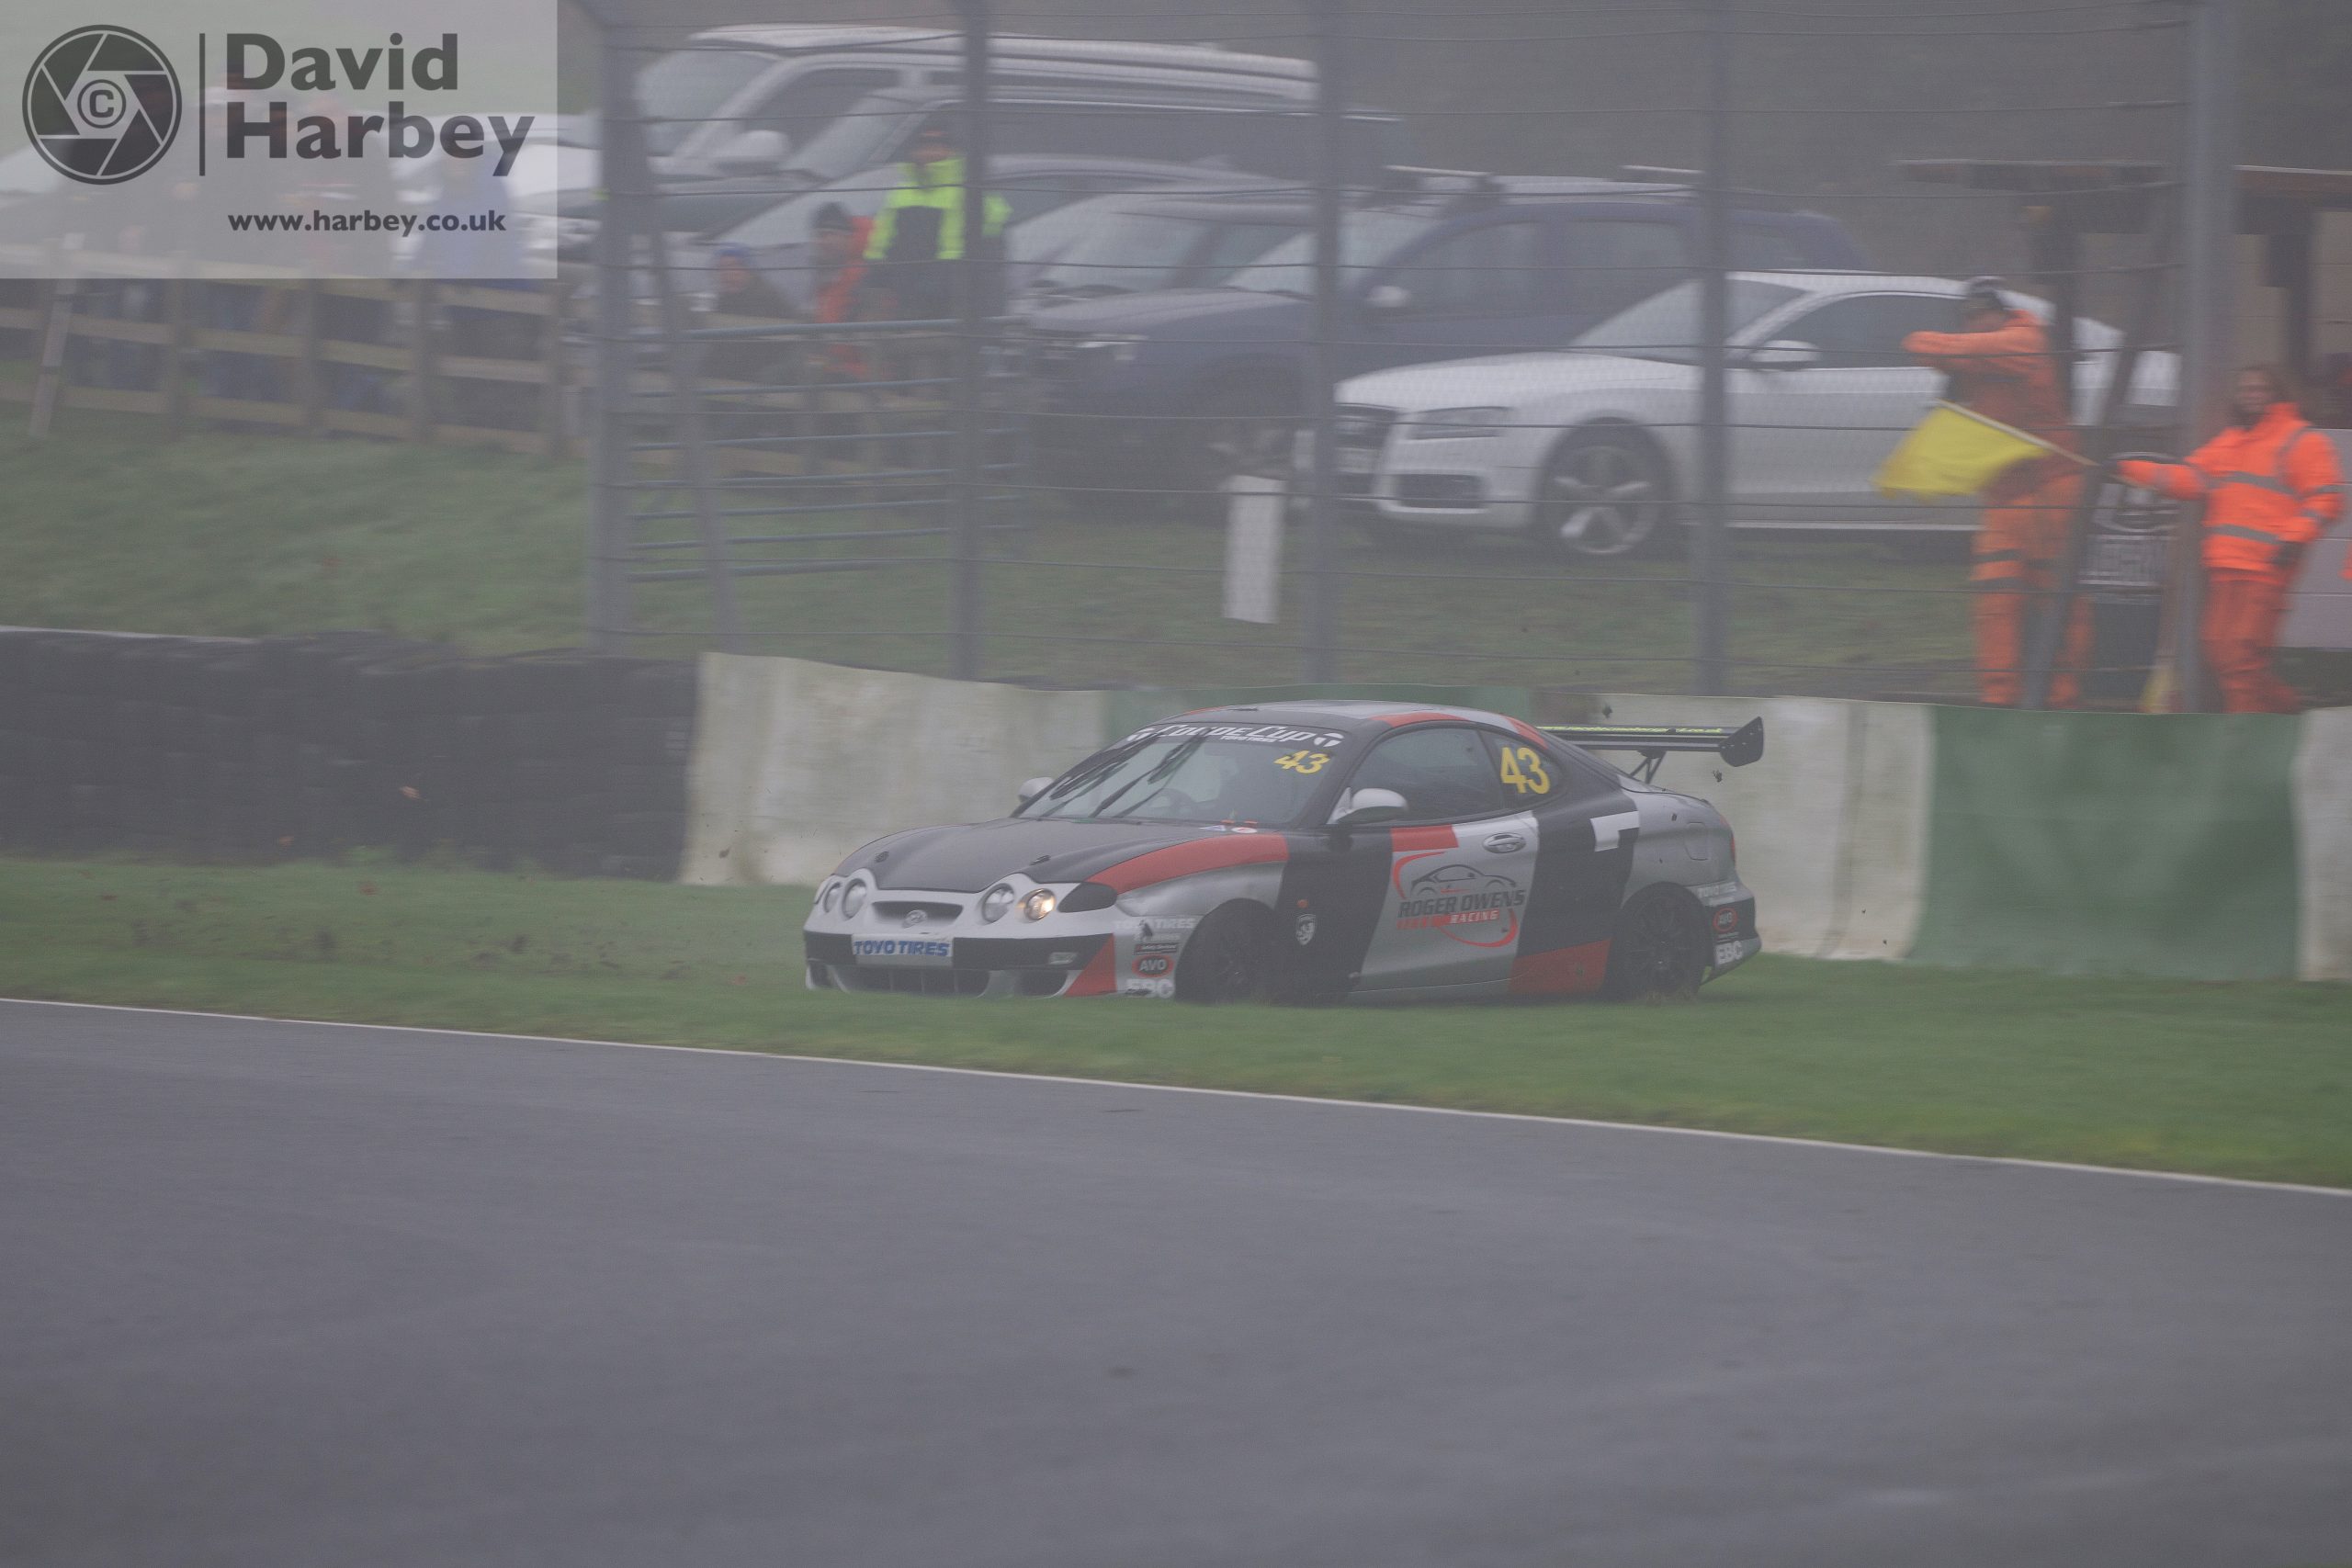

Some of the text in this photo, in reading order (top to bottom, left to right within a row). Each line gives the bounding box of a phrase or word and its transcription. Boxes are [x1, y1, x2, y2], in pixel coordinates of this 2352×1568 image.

[1273, 750, 1330, 773] 43
[1500, 747, 1550, 794] 43
[1397, 889, 1526, 918] ROGER OWENS
[1449, 909, 1499, 924] RACING
[854, 941, 950, 957] TOYO TIRES
[1715, 940, 1743, 964] EBC
[1139, 959, 1167, 971] AVO
